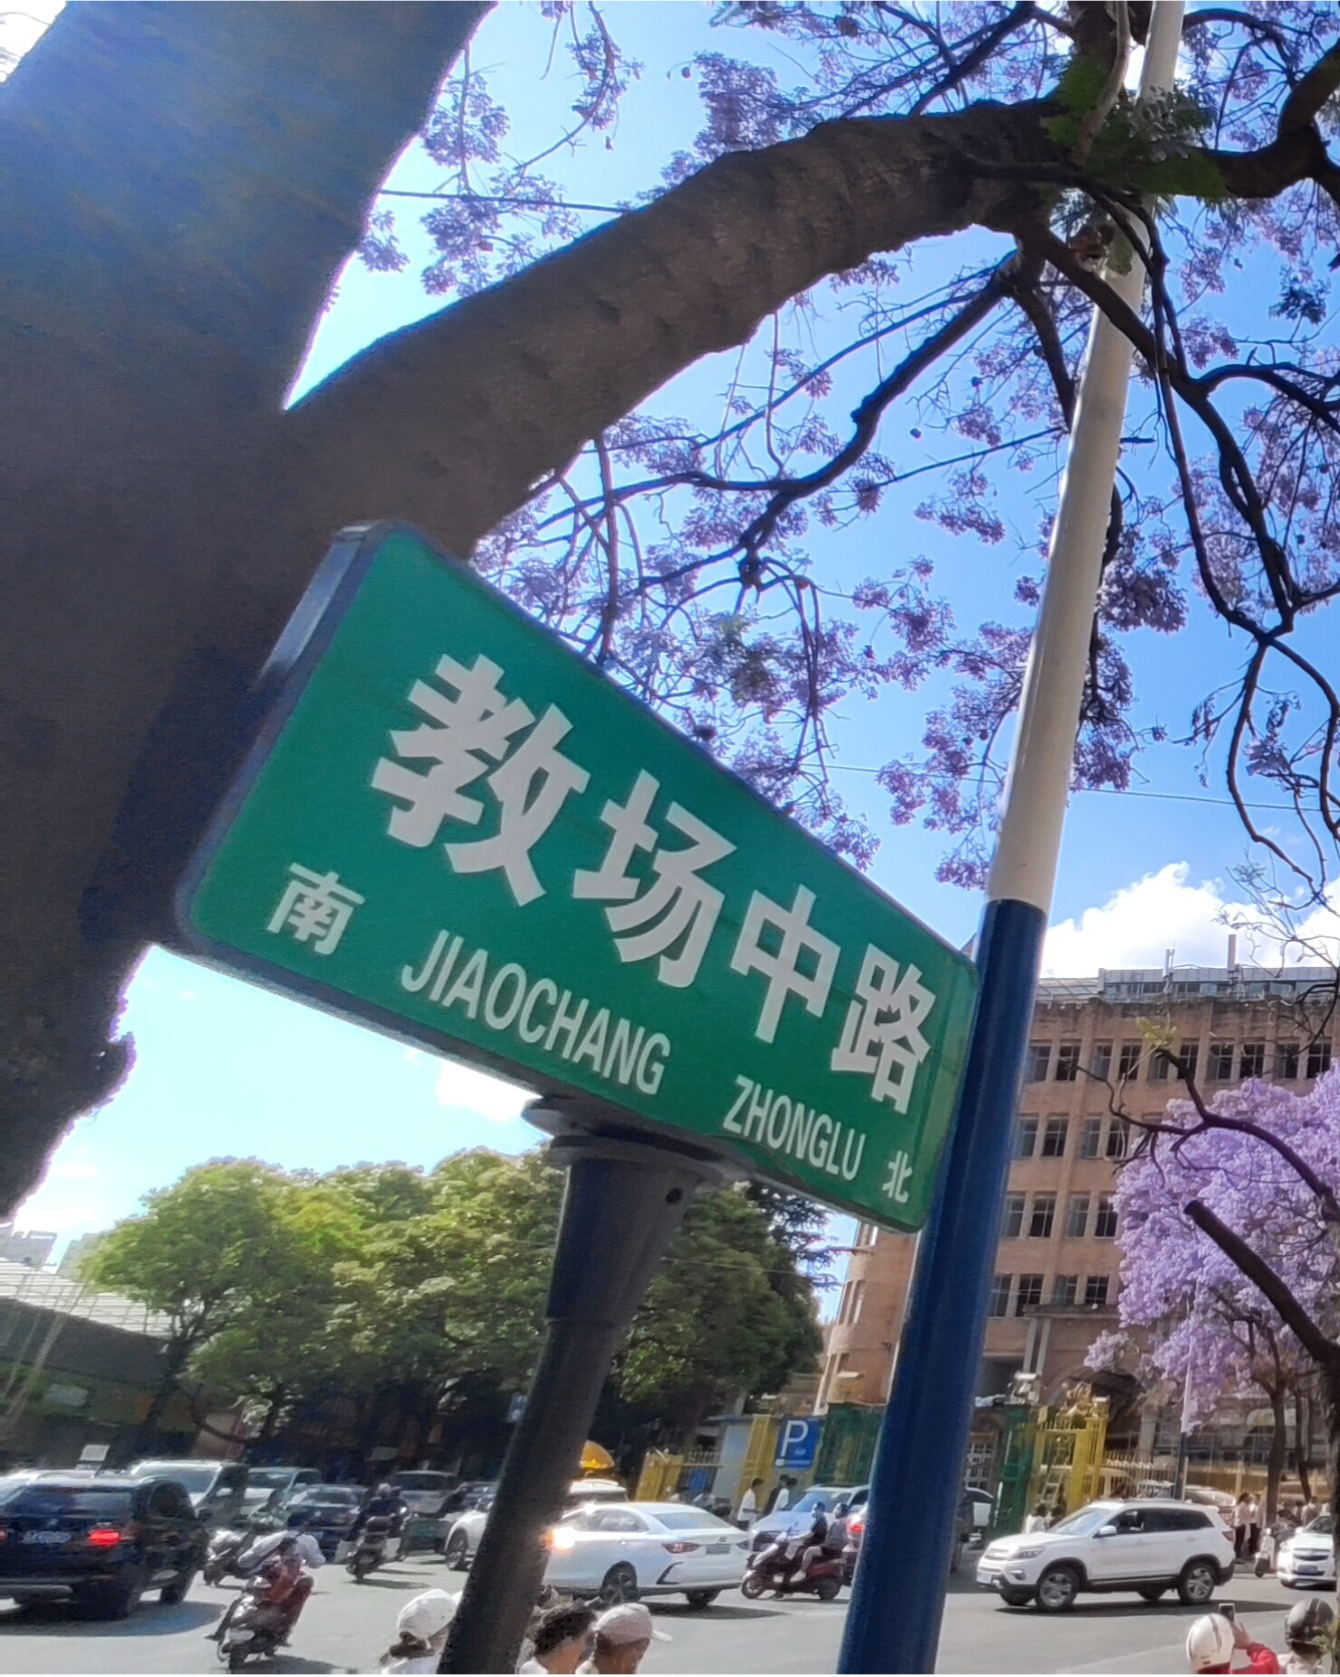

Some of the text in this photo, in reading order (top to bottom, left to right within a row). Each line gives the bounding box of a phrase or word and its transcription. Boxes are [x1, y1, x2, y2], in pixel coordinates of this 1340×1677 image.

[266, 862, 364, 956] 南
[372, 654, 937, 1115] 教场中路
[401, 930, 866, 1182] JIAOCHANG ZHONGLU
[882, 1150, 913, 1204] 北
[780, 1420, 809, 1458] P
